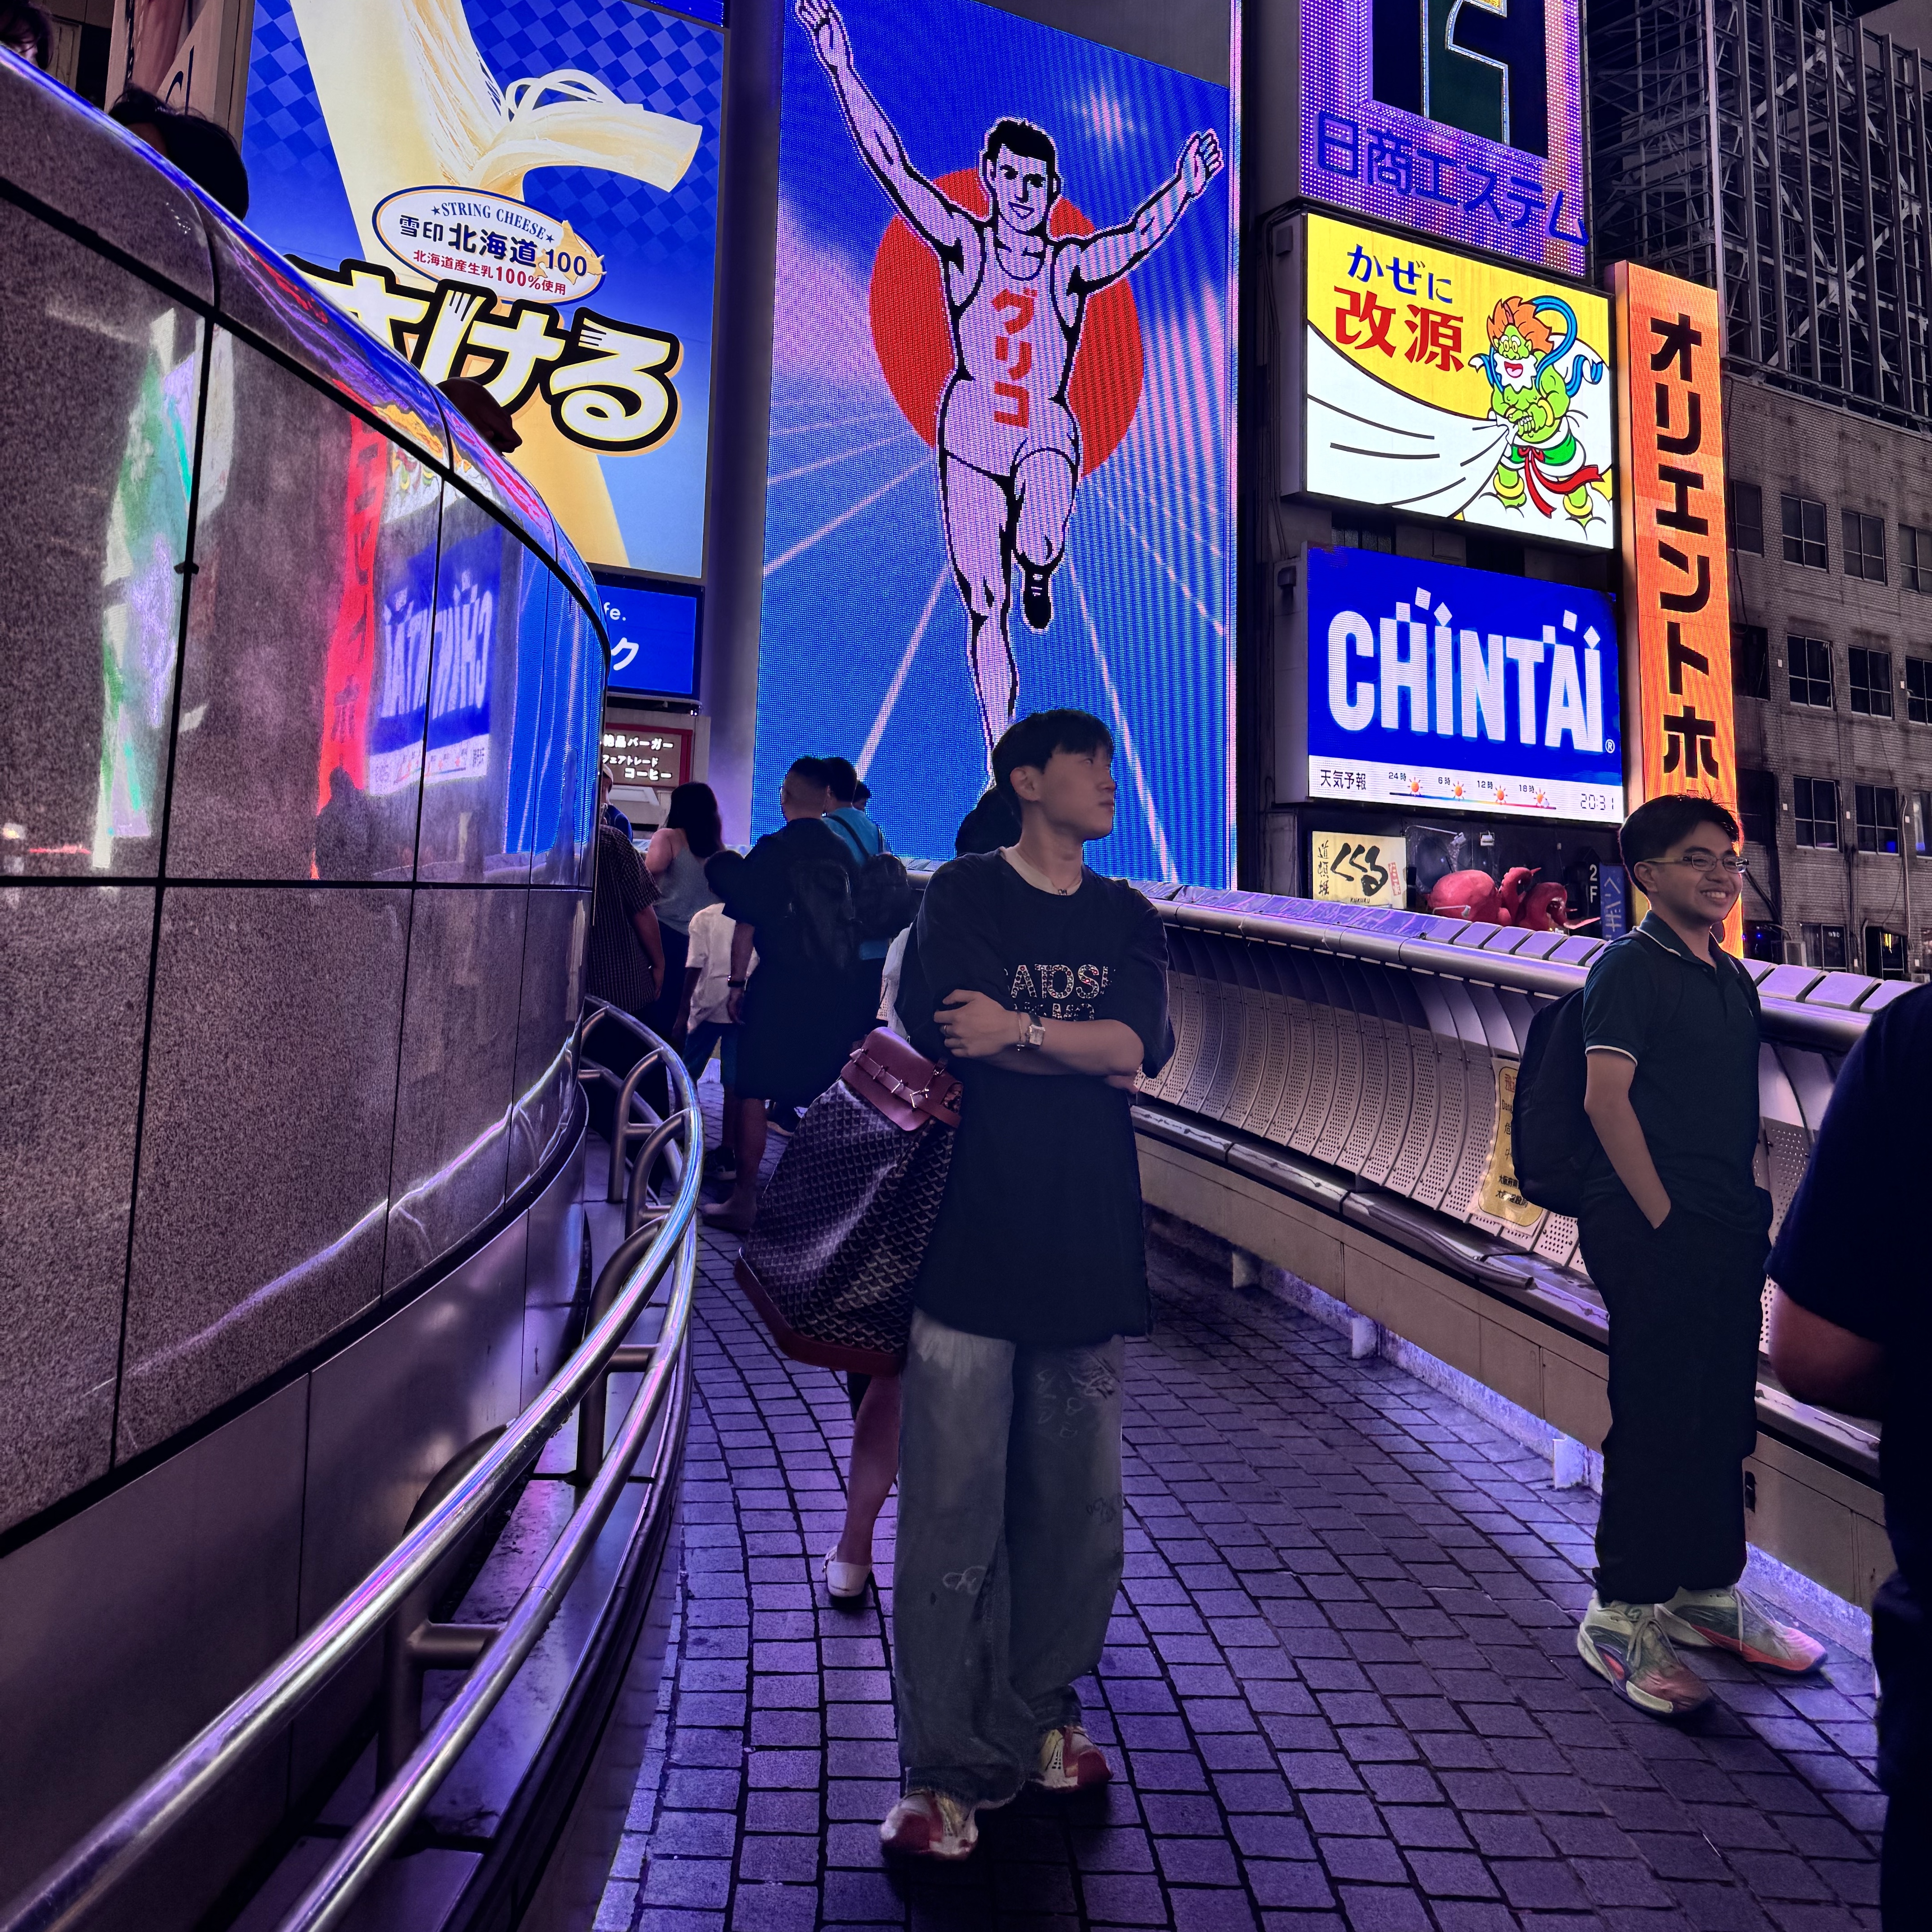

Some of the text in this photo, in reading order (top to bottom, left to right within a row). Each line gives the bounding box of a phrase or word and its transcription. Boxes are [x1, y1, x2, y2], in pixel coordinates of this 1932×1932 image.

[1316, 109, 1588, 246] 日商エステム
[442, 202, 547, 239] STRING CHEESE
[414, 250, 566, 295] 北海道産生乳100%使用
[1347, 244, 1452, 303] かぜに
[1334, 286, 1463, 372] 改源
[992, 287, 1037, 429] グリコ
[1650, 312, 1719, 793] オリエントホ
[611, 637, 639, 670] ク
[1328, 587, 1602, 753] CHINTAI
[603, 754, 658, 767] フェアトレード
[625, 767, 672, 780] コーヒー
[1320, 769, 1366, 791] 天気予報
[1580, 793, 1615, 810] 20:31
[1330, 842, 1389, 897] くくる
